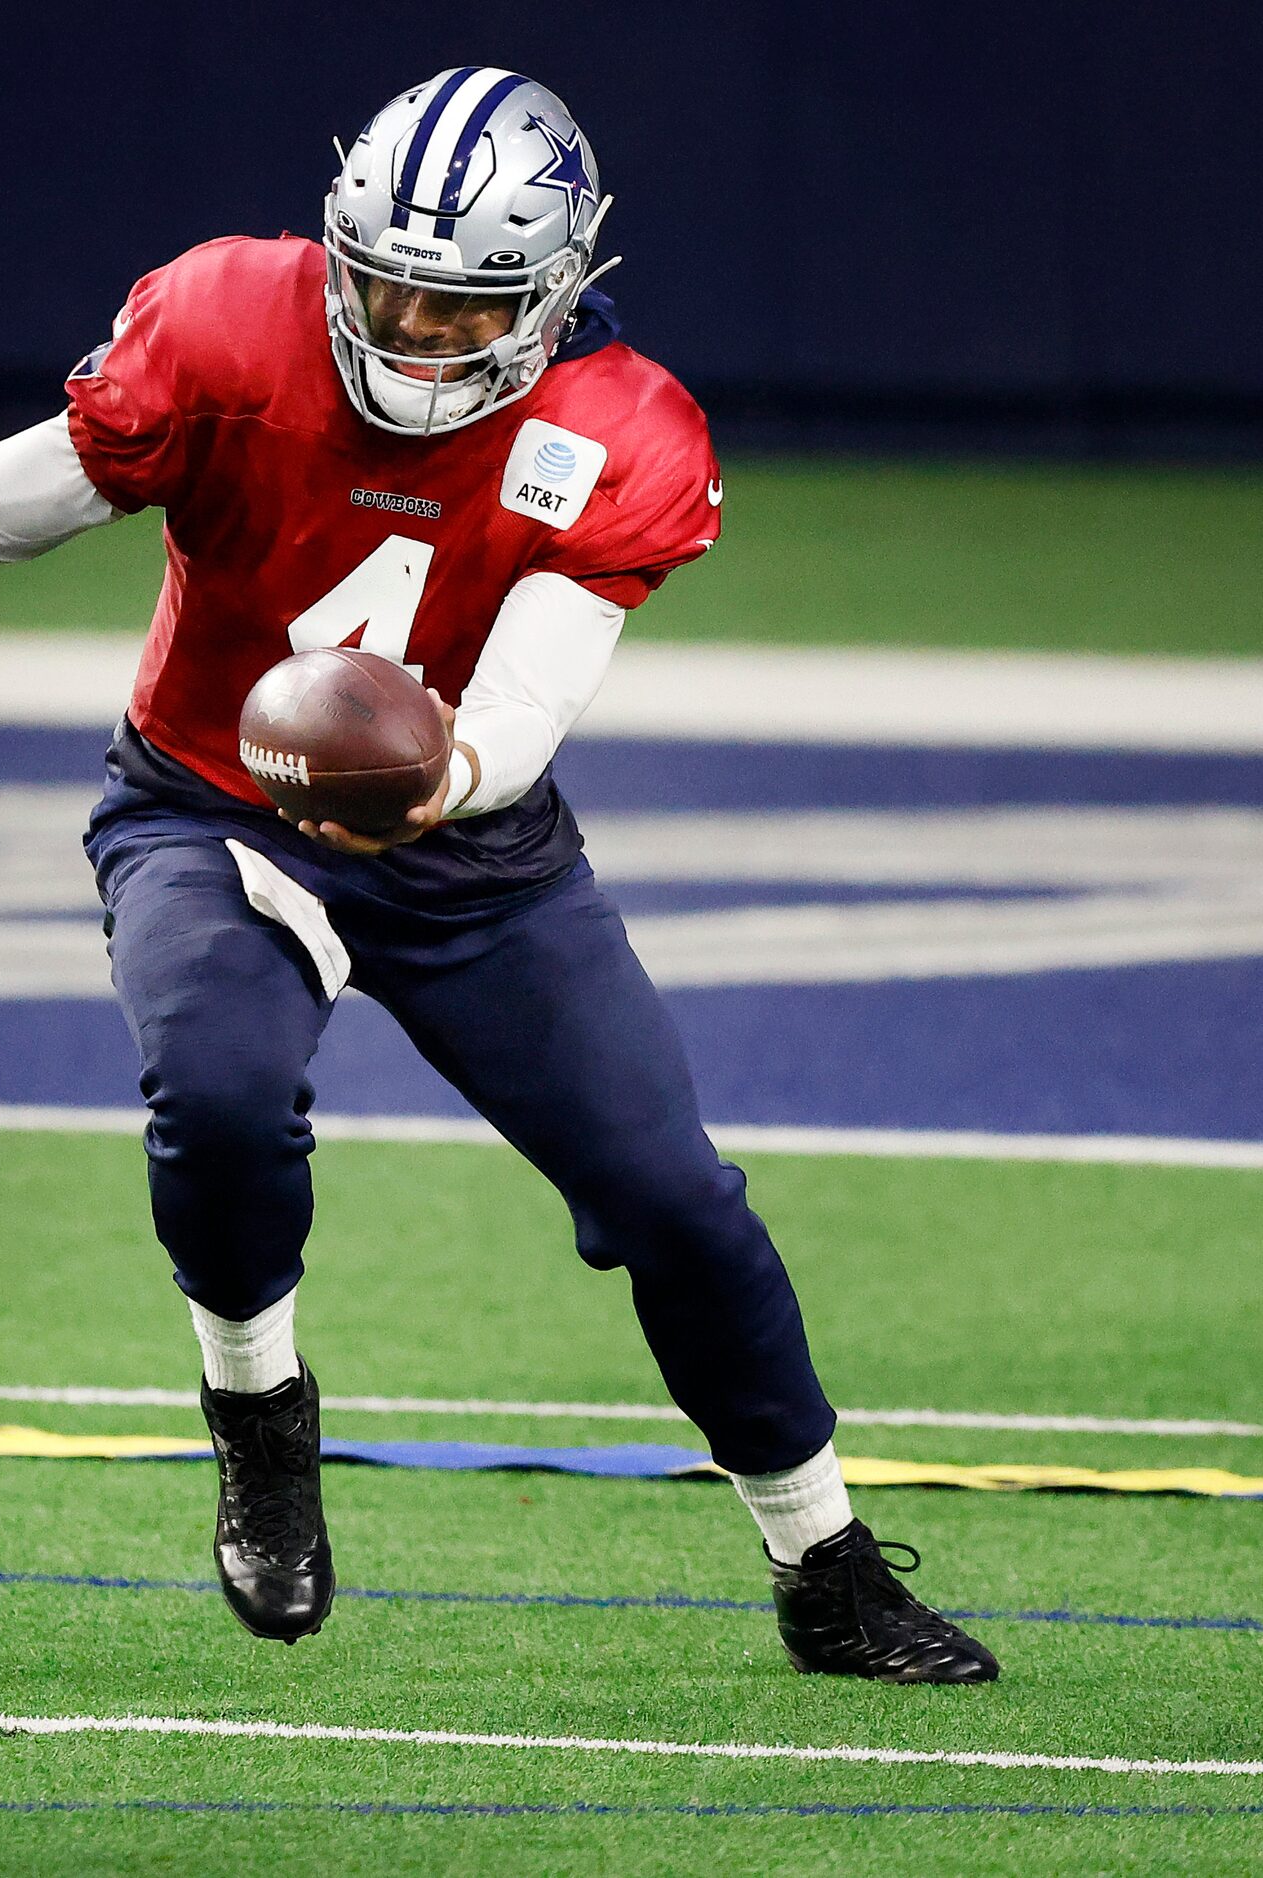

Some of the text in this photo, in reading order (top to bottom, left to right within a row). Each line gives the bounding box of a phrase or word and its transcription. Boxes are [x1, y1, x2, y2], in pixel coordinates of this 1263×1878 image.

[391, 242, 442, 261] COWBOYS
[350, 488, 441, 519] COWBOYS
[516, 483, 568, 512] AT&T
[287, 533, 435, 684] 4
